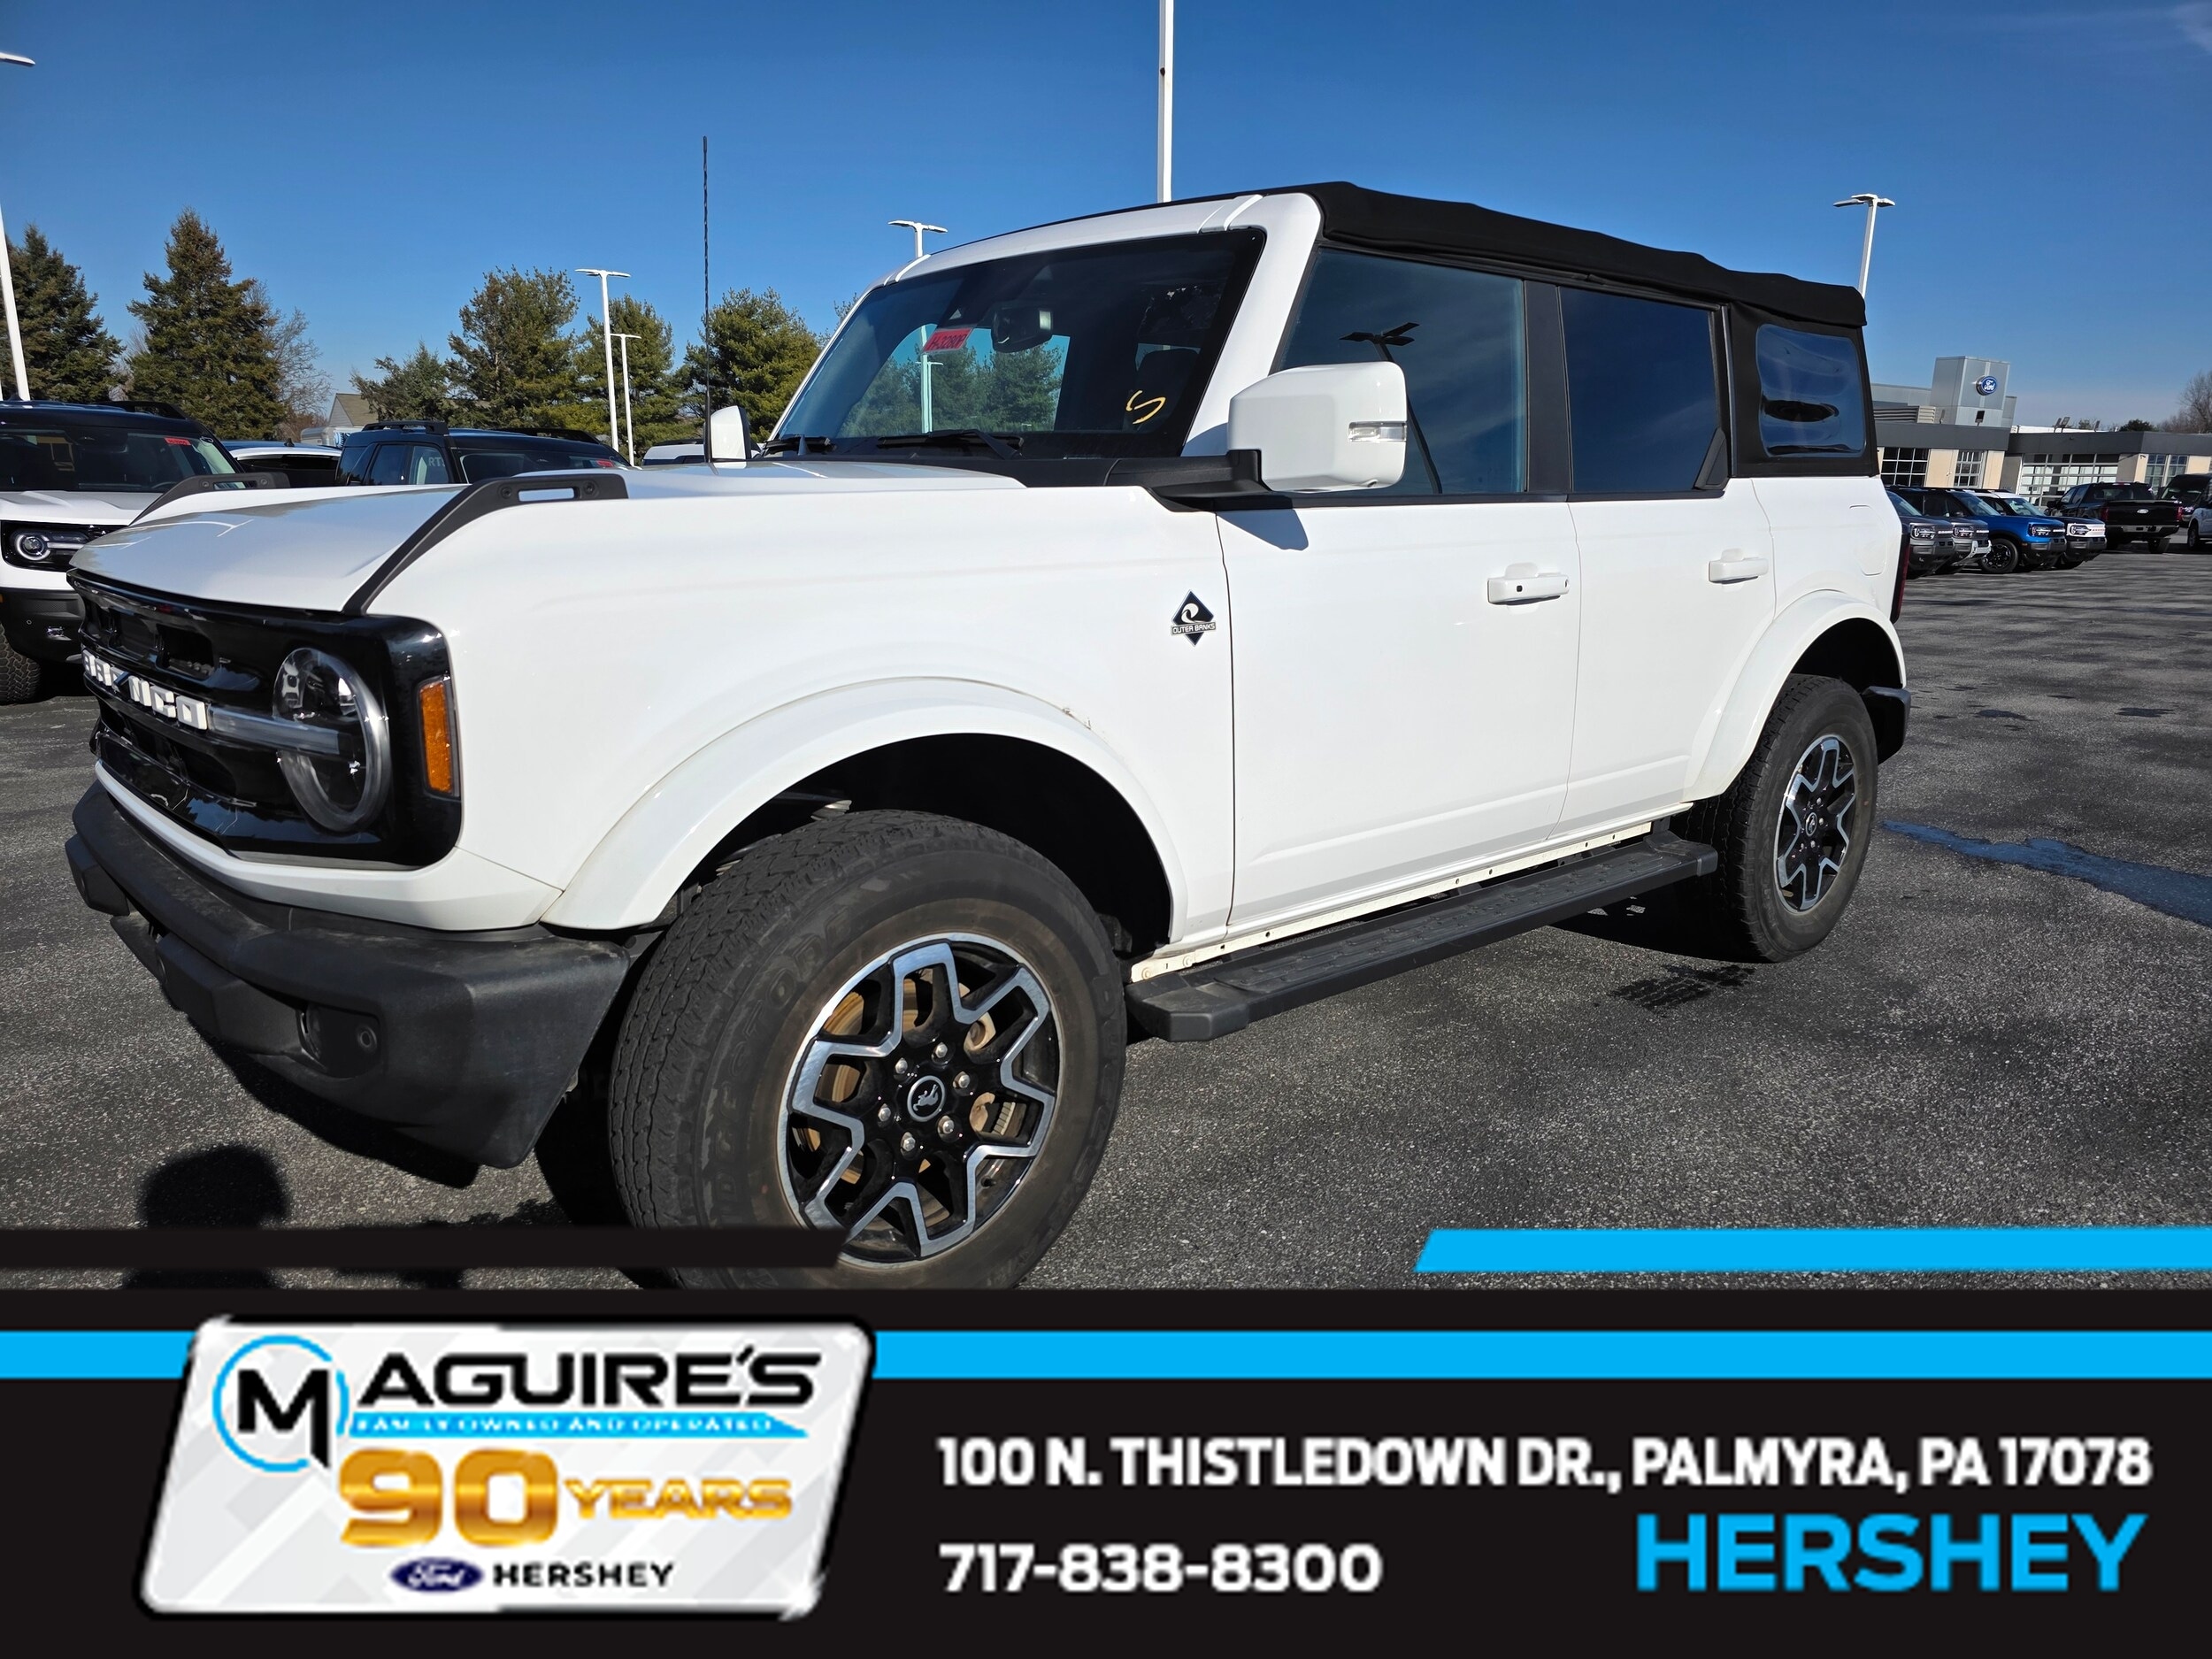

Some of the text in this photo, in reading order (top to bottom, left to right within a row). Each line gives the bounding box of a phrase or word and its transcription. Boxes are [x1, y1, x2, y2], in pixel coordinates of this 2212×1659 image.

[1983, 378, 1996, 391] Ford
[1172, 622, 1215, 634] OUTER BANKS
